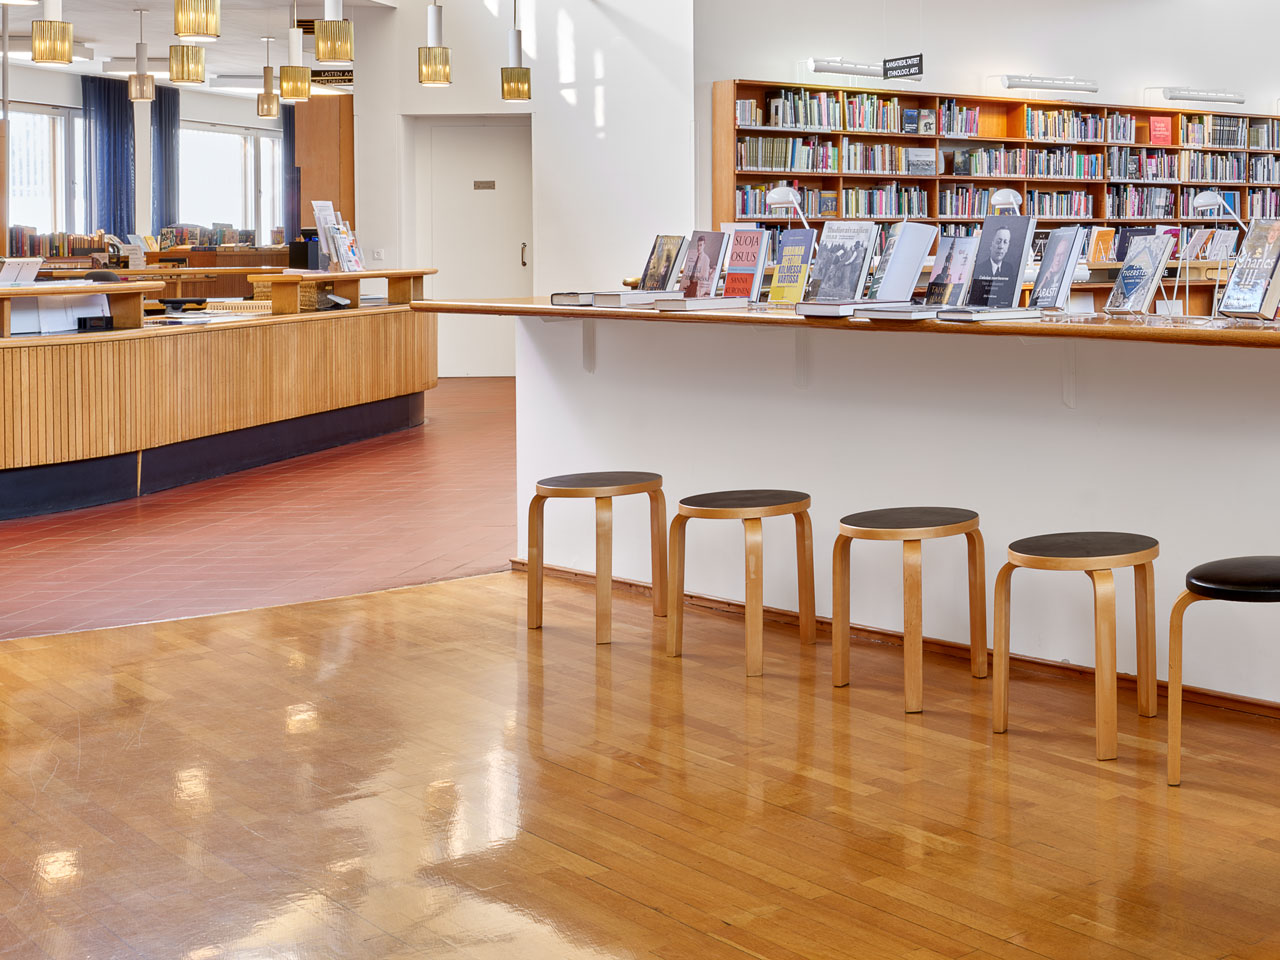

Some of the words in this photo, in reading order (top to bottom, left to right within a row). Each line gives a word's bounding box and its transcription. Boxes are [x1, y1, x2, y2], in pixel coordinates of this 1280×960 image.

[734, 235, 760, 247] SUOJA
[731, 251, 757, 262] OSUUS
[1236, 251, 1275, 269] Charles
[778, 264, 802, 274] KOLMESSA
[777, 274, 799, 284] VARTISSA
[1241, 269, 1258, 284] III
